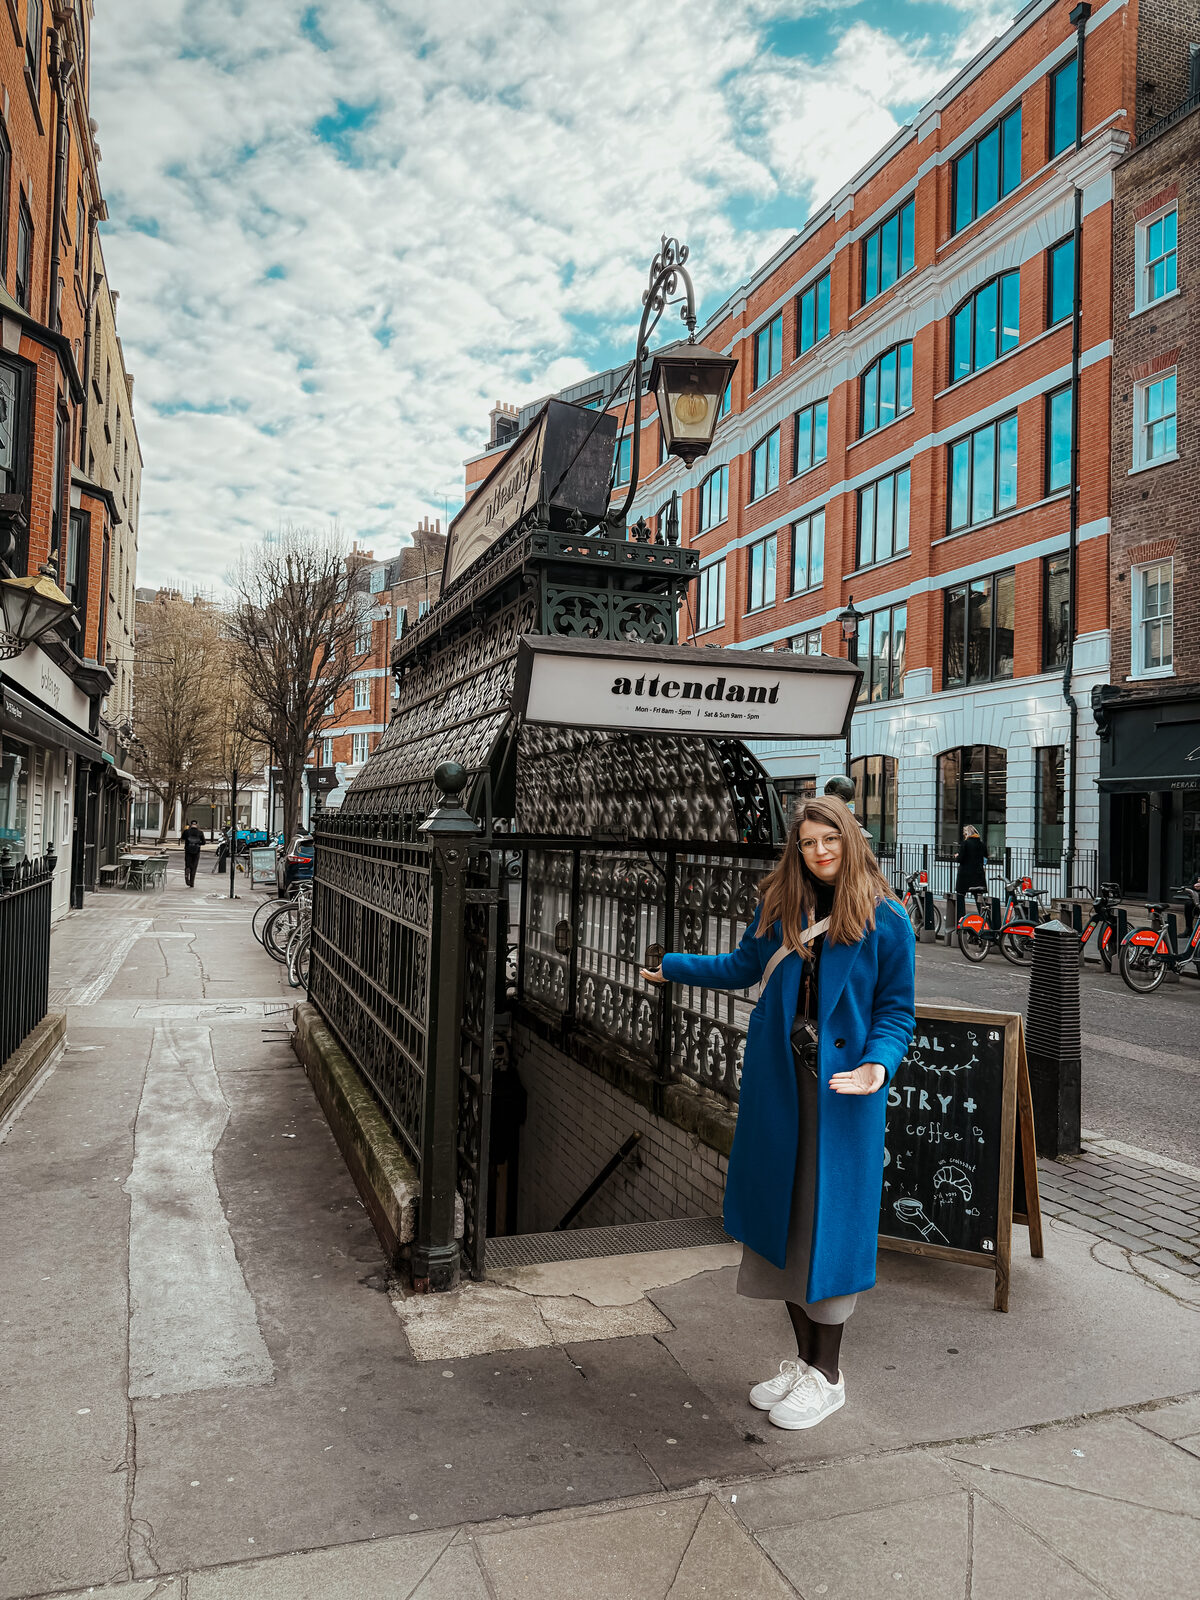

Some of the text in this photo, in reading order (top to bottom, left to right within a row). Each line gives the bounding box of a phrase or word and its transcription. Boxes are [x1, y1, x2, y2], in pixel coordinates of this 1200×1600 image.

[611, 673, 781, 704] attendant
[887, 1086, 953, 1114] STRY
[906, 1122, 963, 1143] coffee
